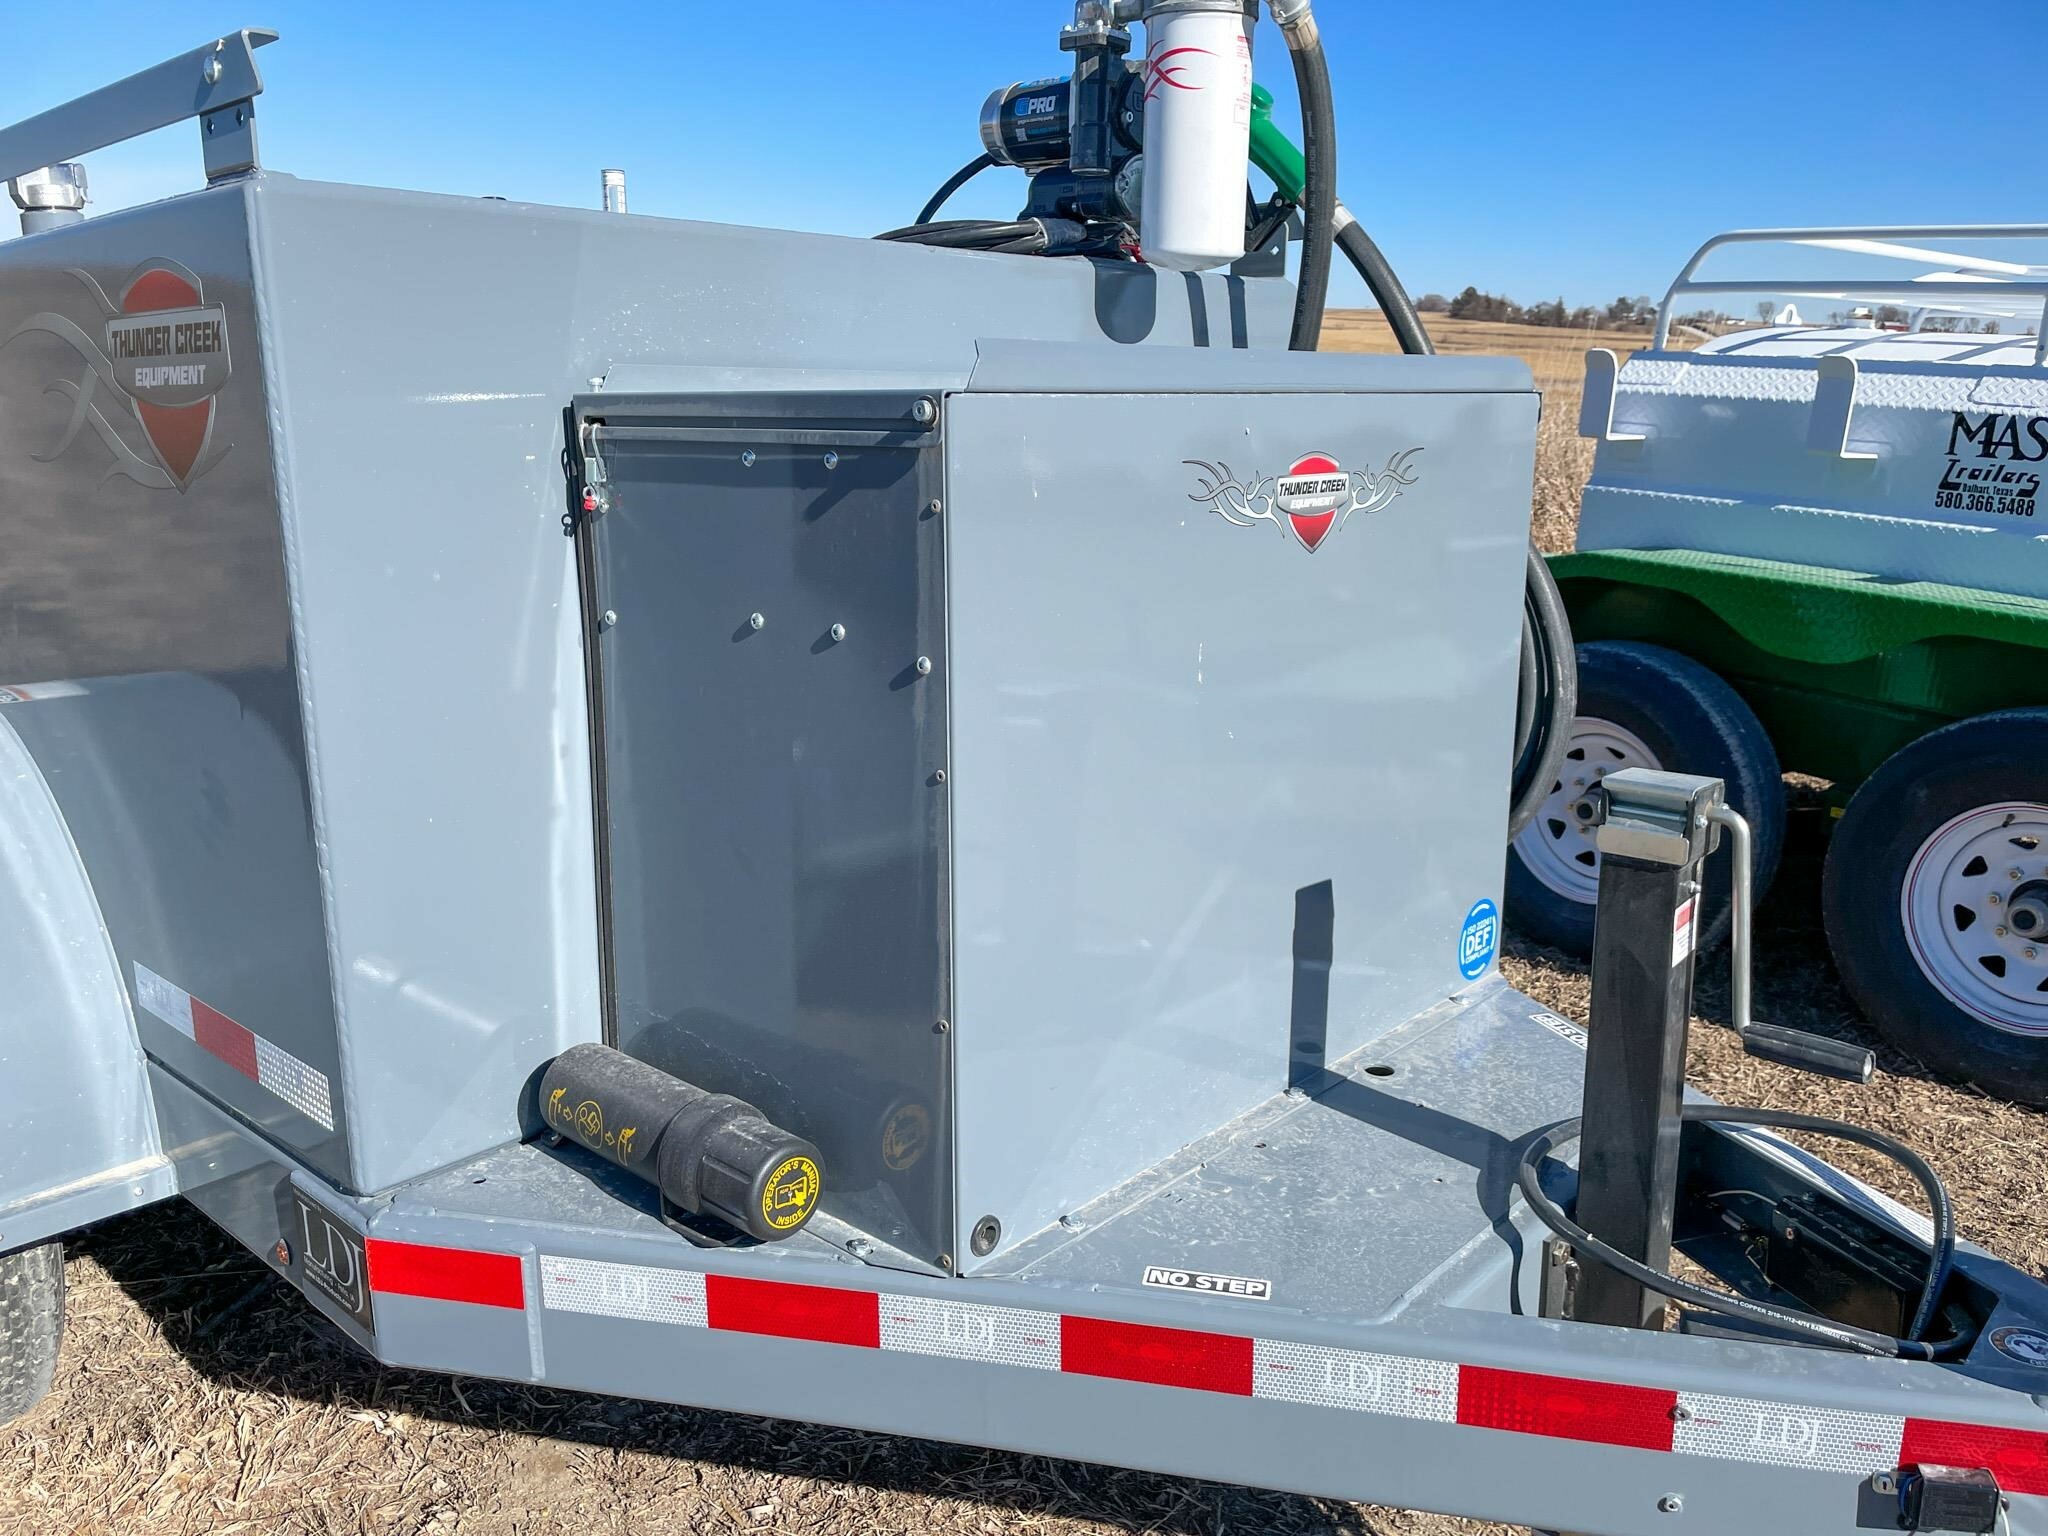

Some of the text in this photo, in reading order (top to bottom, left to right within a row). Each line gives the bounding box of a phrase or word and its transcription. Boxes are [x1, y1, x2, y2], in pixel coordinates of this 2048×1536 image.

[112, 320, 222, 358] THUNDER CREEK
[135, 364, 207, 389] EQUIPMENT
[1279, 478, 1347, 497] THUNDER CREEK
[1938, 458, 2041, 499] Trailers
[1993, 486, 2014, 497] Texas
[1290, 496, 1336, 509] EQUIPMENT
[1935, 491, 2036, 517] 580.366.5488
[1465, 926, 1491, 956] DEF
[765, 1160, 817, 1211] OPERATOR'S MANUAL
[776, 1208, 804, 1225] INSIDE
[297, 1200, 364, 1313] LDJ
[1148, 1269, 1265, 1295] NO STEP
[1739, 1301, 1767, 1314] COPPER
[1750, 1413, 1824, 1458] LDJ
